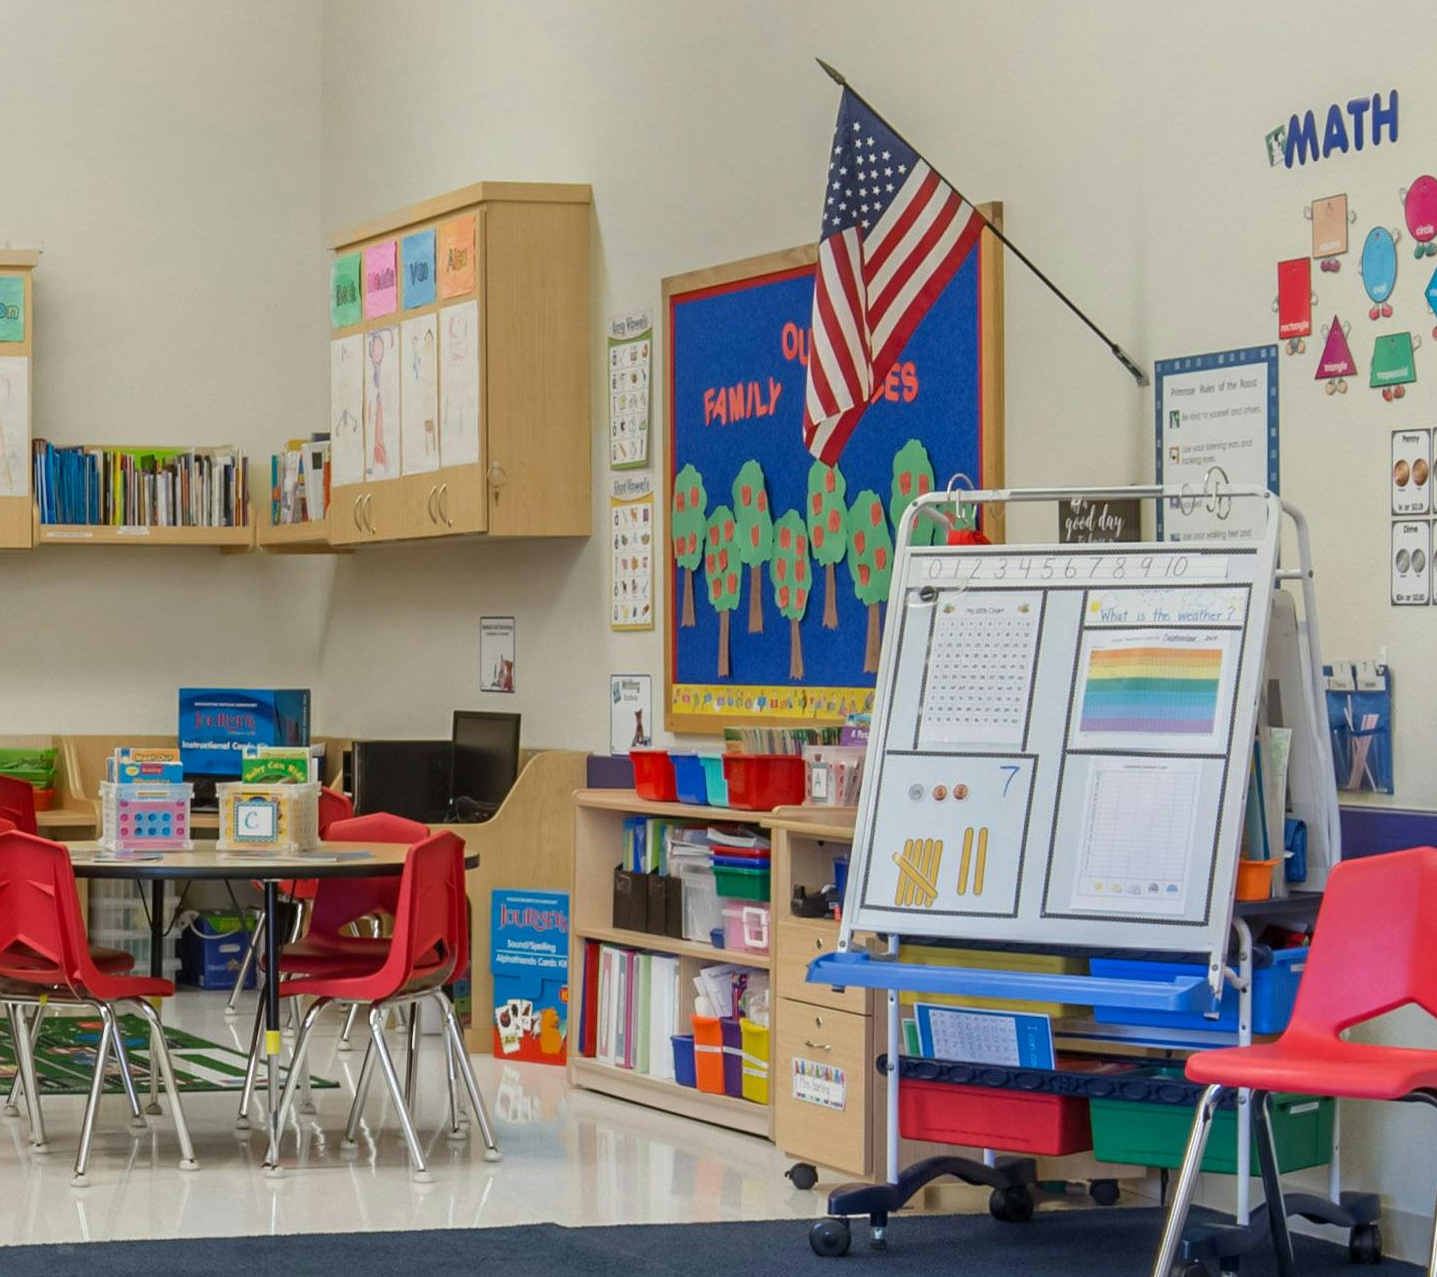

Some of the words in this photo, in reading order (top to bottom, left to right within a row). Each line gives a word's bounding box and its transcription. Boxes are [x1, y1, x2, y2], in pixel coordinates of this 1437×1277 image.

[1284, 89, 1399, 169] MATH
[703, 376, 782, 426] FAMILY
[1402, 435, 1420, 445] Penny
[1065, 504, 1096, 541] good
[1097, 504, 1125, 539] day
[1403, 525, 1418, 534] Dime
[929, 560, 942, 579] 0
[953, 560, 961, 579] 1
[970, 559, 983, 579] 2
[994, 558, 1007, 579] 3
[1019, 558, 1032, 579] 4
[1040, 558, 1057, 579] 5
[1064, 557, 1078, 579] 6
[1089, 557, 1103, 578] 7
[1112, 557, 1126, 578] 8
[1140, 557, 1153, 577] 9
[1164, 556, 1189, 577] 10
[1100, 608, 1128, 622] What
[1137, 609, 1146, 621] is
[1153, 609, 1168, 621] the
[1177, 609, 1222, 621] weather
[182, 740, 230, 751] Instructional
[999, 766, 1020, 797] 7
[245, 811, 259, 829] C
